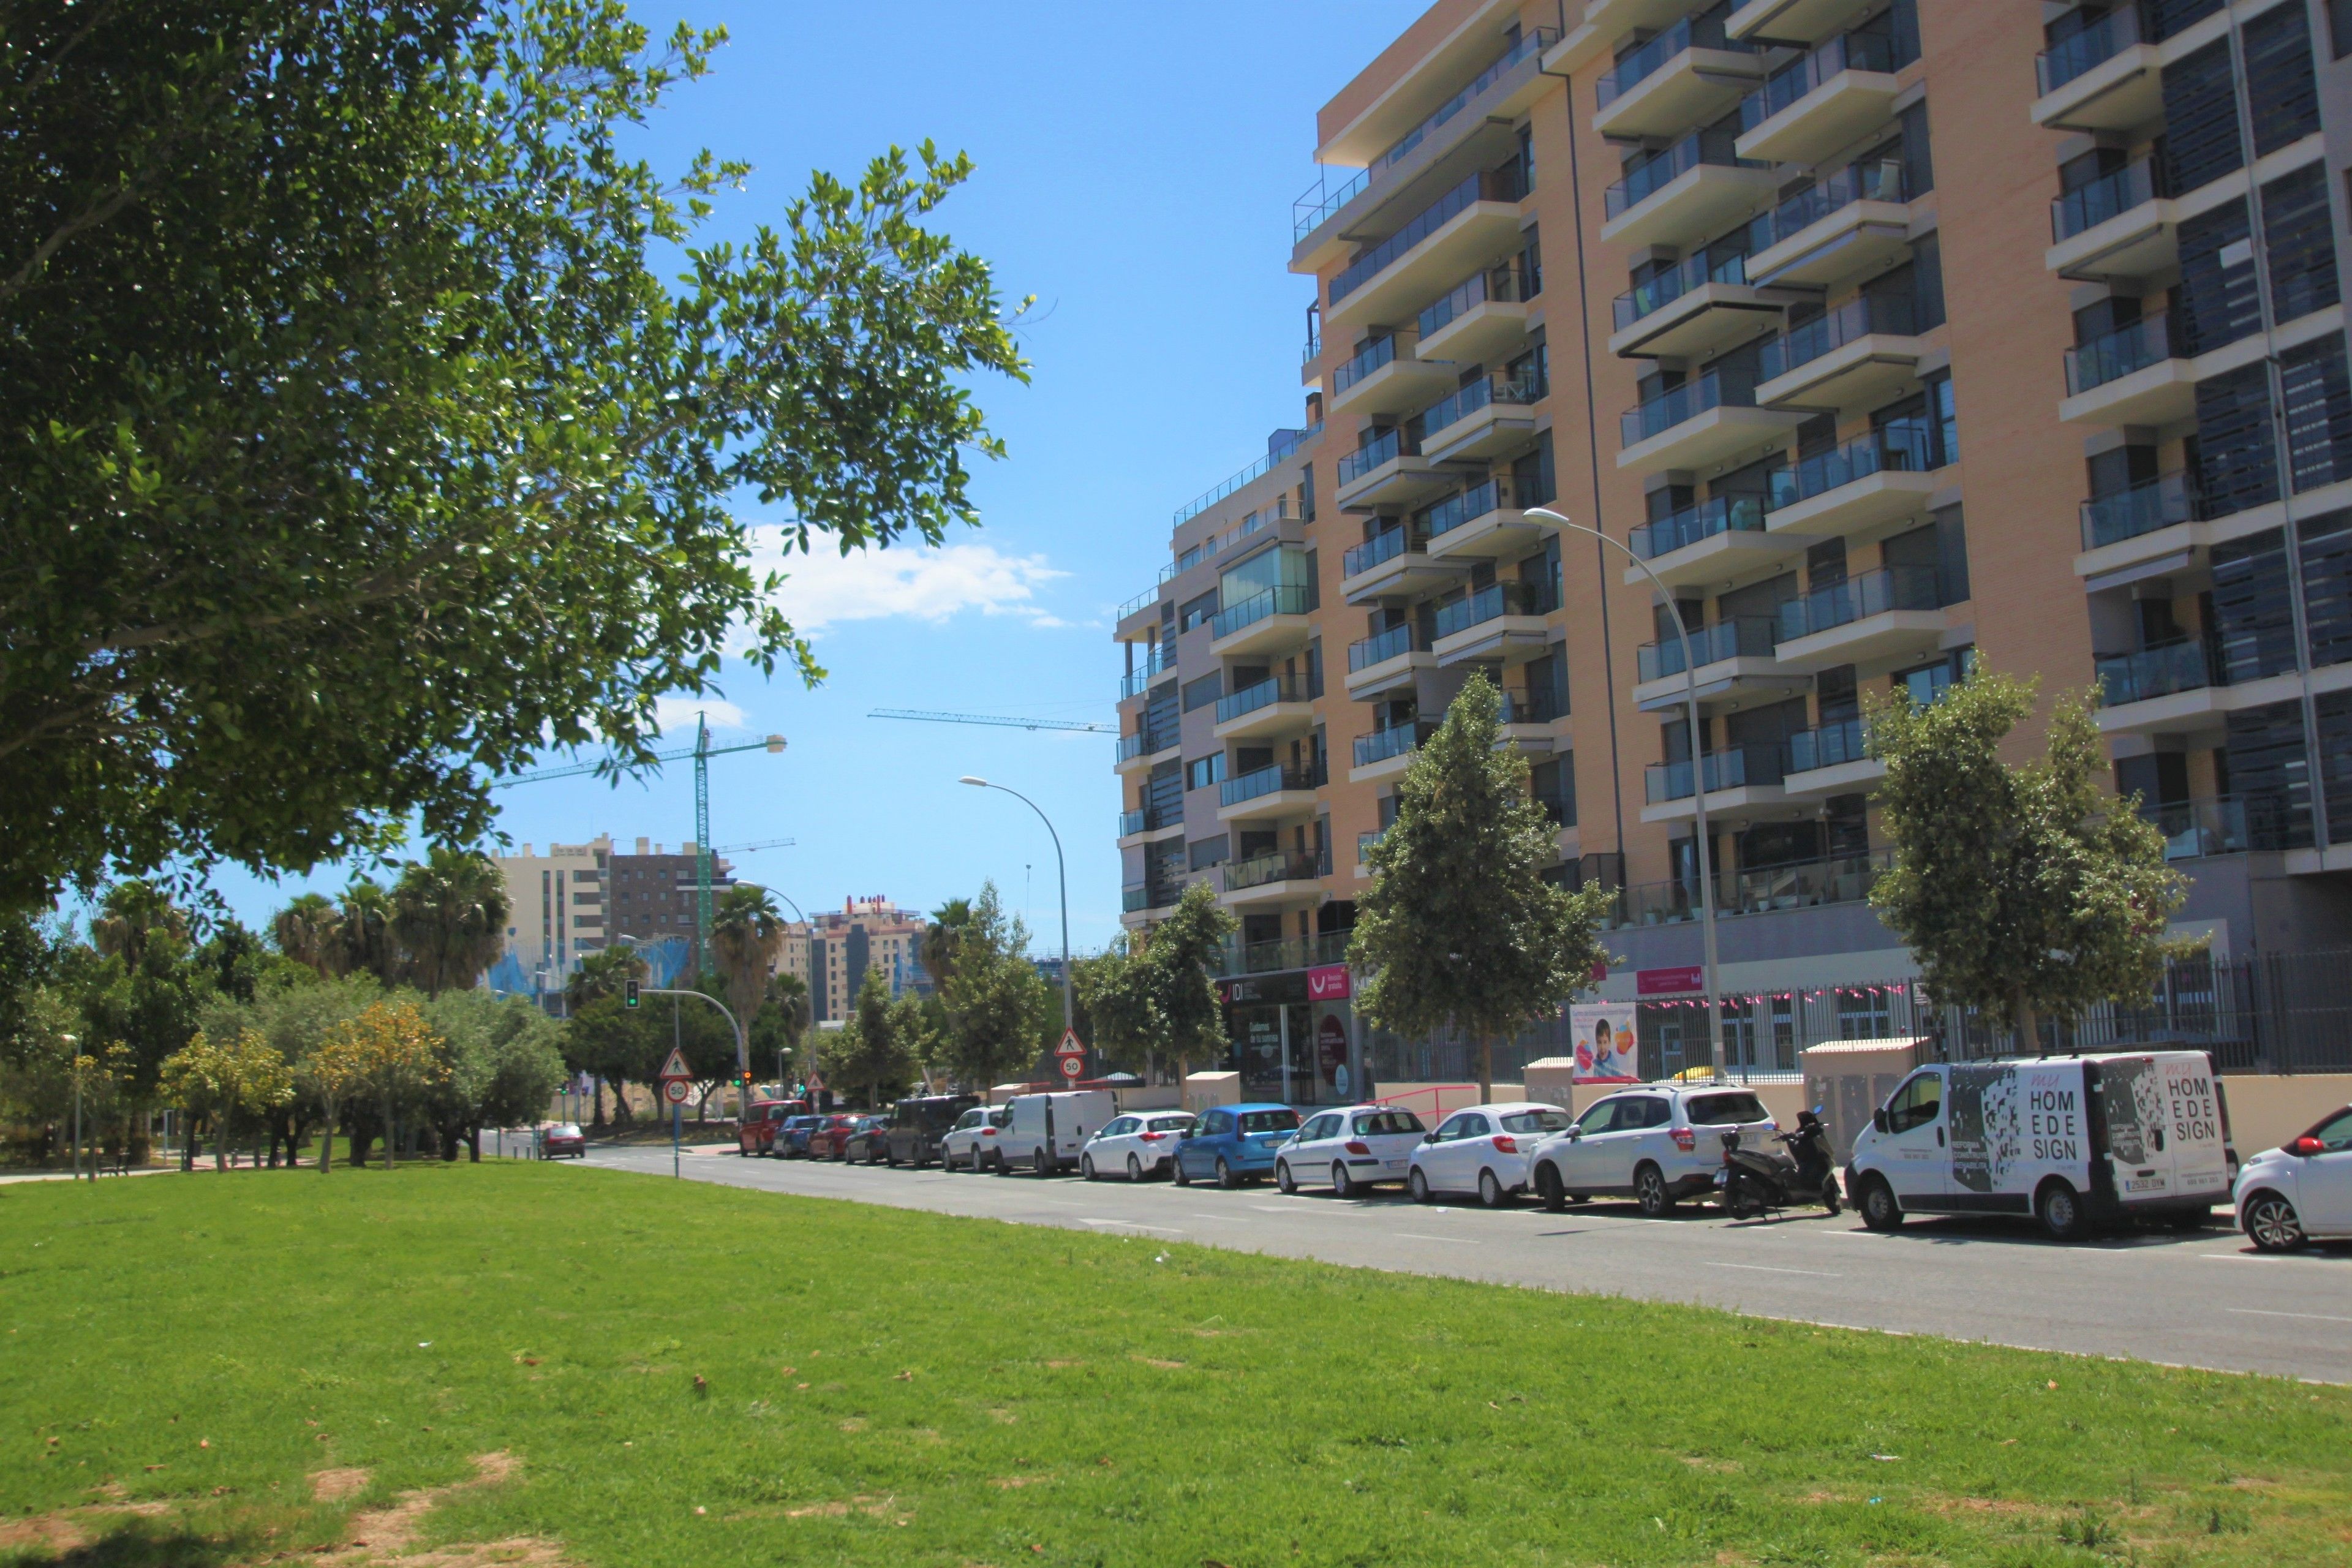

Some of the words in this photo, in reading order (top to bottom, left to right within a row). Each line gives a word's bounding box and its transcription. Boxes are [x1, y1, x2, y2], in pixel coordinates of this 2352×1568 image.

[2031, 1074, 2060, 1095] my
[2168, 1078, 2209, 1096] HOM
[2031, 1090, 2074, 1111] HOM
[2176, 1121, 2215, 1140] SIGN
[2033, 1139, 2077, 1160] SIGN
